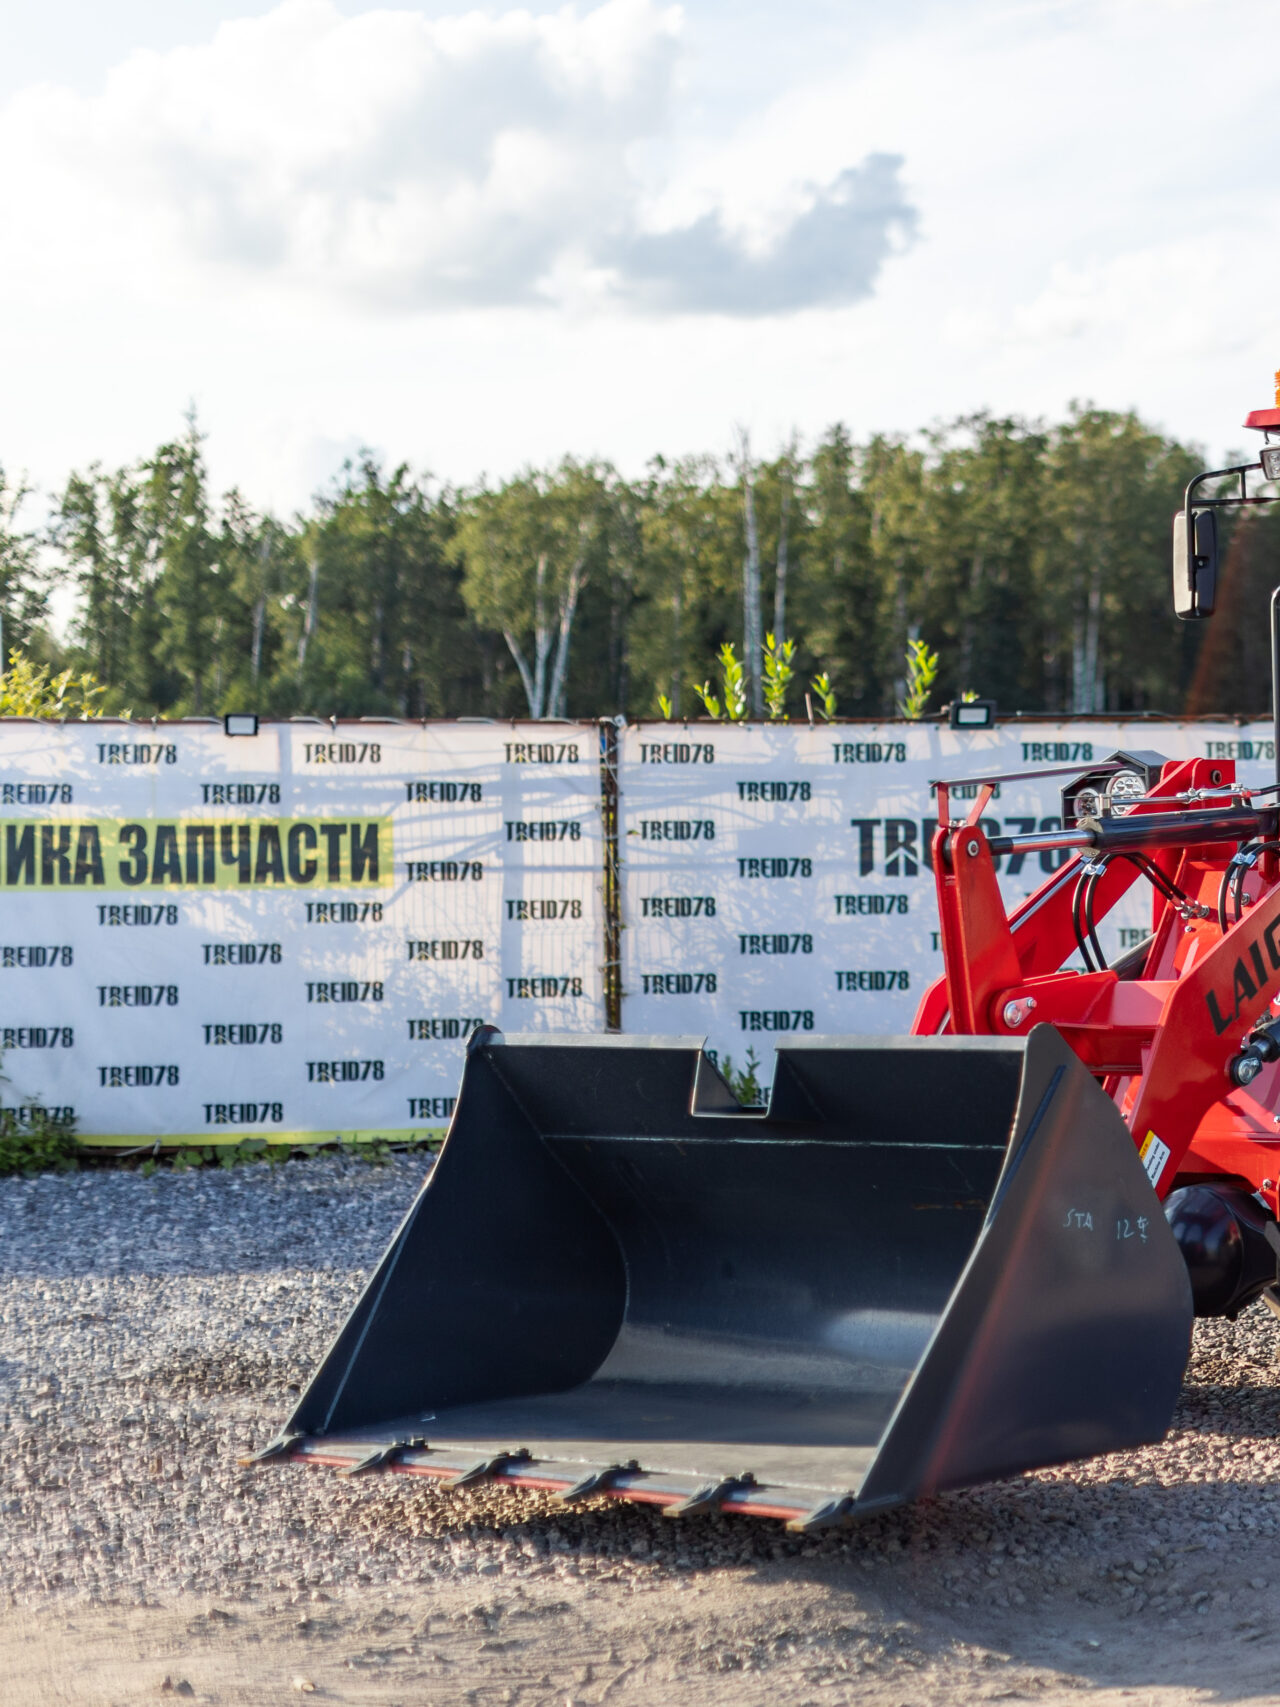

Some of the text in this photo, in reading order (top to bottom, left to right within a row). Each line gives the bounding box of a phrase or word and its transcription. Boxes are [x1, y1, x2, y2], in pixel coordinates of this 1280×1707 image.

[95, 742, 178, 765] TREID78
[303, 742, 382, 764] TREID78
[502, 742, 580, 764] TREID78
[637, 743, 715, 764] TREID78
[831, 742, 907, 763] TREID78
[1021, 741, 1094, 762] TREID78
[1205, 741, 1276, 760] TREID78
[0, 783, 74, 805] REID78
[200, 783, 281, 805] TREID78
[402, 781, 483, 803] TREID78
[735, 781, 812, 802] TREID78
[928, 779, 1001, 800] TEID8
[503, 820, 582, 842] TREID78
[638, 819, 715, 841] TREID78
[4, 822, 380, 886] ИКА ЗАПЧАСТИ
[402, 860, 484, 882] TREID78
[736, 857, 813, 879] TREID78
[95, 904, 179, 926] TREID78
[303, 901, 384, 923] TREID78
[504, 899, 583, 920] TREID78
[639, 896, 717, 918] TREID78
[833, 894, 909, 916] TREID78
[201, 942, 283, 965] TREID78
[404, 938, 484, 961] TREID78
[737, 933, 814, 955] TREID78
[0, 945, 74, 967] REID78
[304, 980, 385, 1003] TREID78
[505, 976, 584, 998] TREID78
[640, 972, 718, 994] TREID78
[834, 970, 911, 992] TREID78
[96, 984, 179, 1007] TREID78
[737, 1009, 815, 1032] TREID78
[0, 1026, 74, 1048] REID78
[201, 1022, 284, 1045] TREID78
[97, 1064, 180, 1087] TREID78
[304, 1059, 385, 1083] TREID78
[201, 1101, 284, 1124] TREID78
[407, 1098, 458, 1119] TREI
